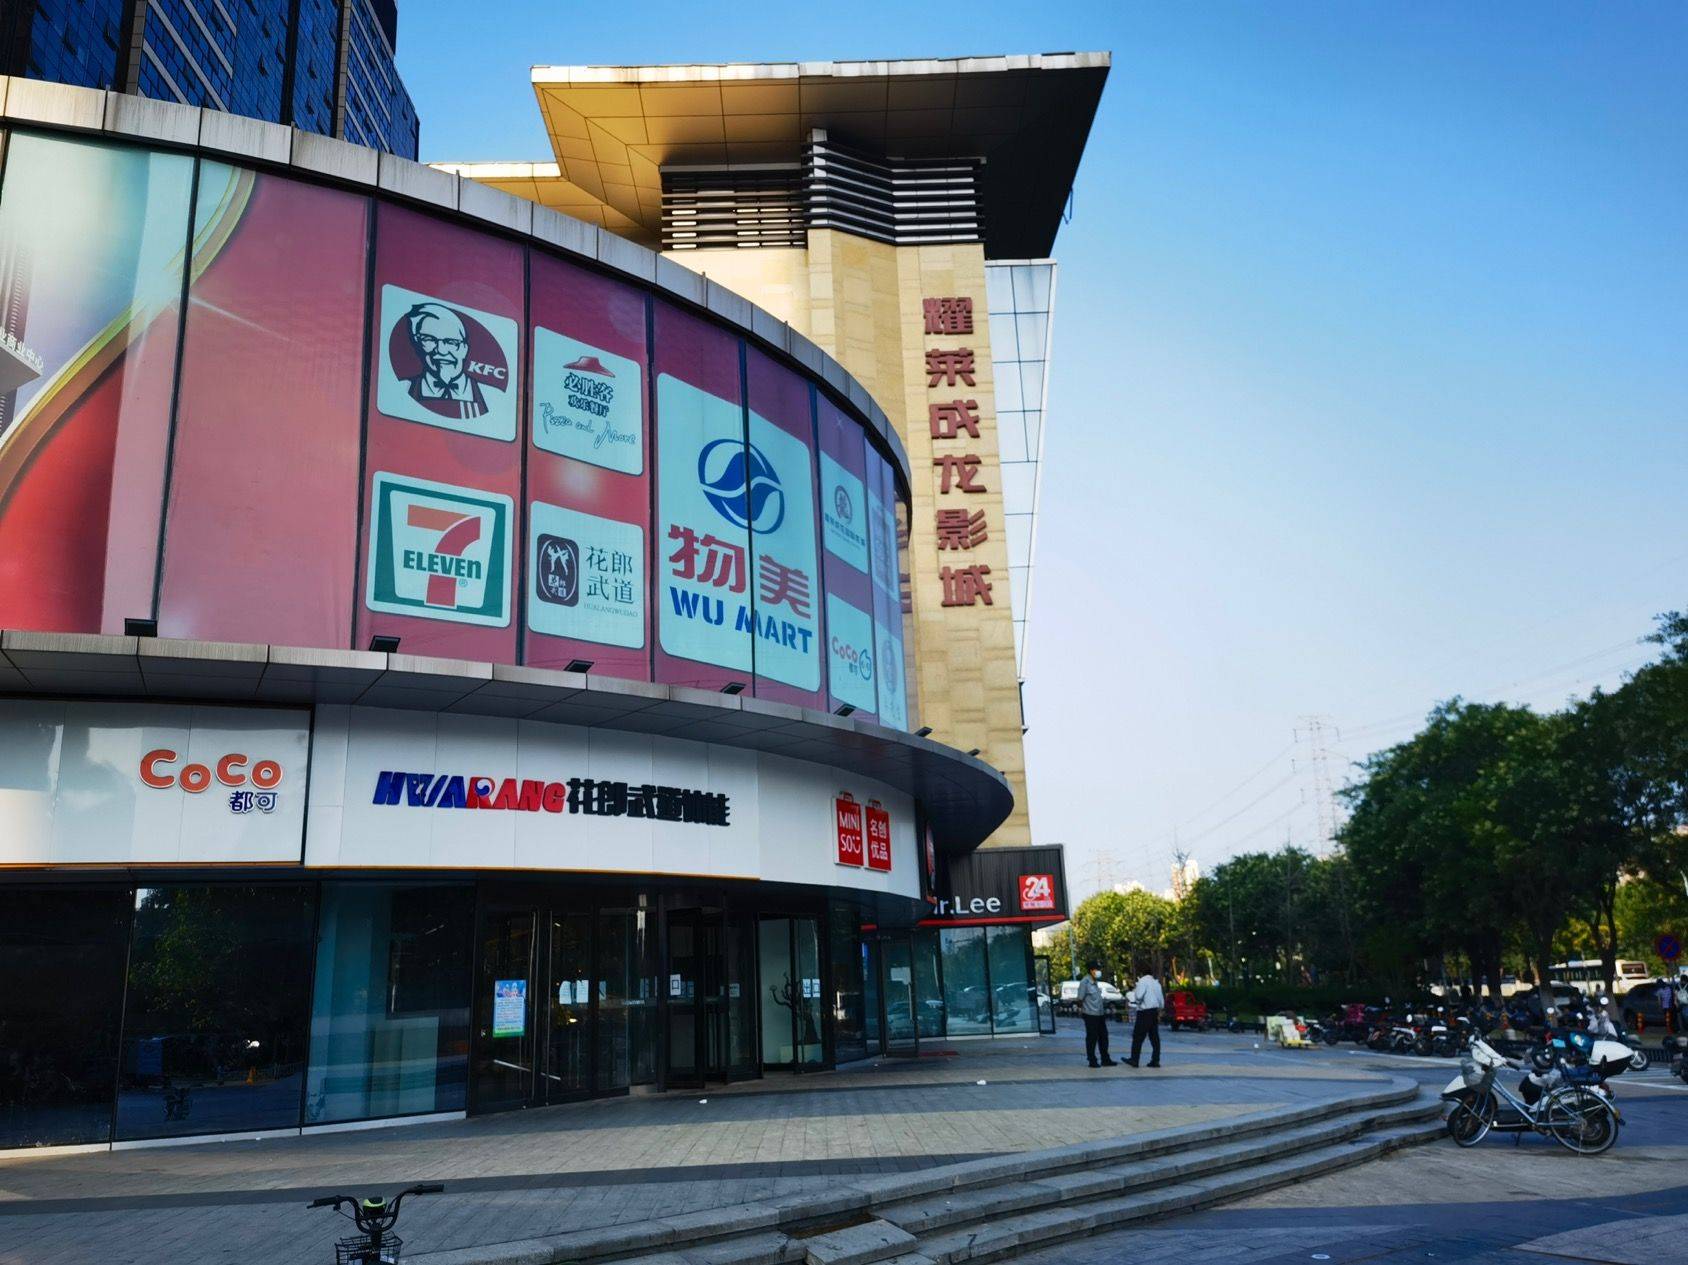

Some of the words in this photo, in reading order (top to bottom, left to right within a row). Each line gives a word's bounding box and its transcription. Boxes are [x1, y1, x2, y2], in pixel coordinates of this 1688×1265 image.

[468, 360, 506, 380] KFC
[564, 372, 613, 404] 必胜客
[922, 297, 994, 607] 耀莱成龙影城
[585, 545, 633, 575] 花郎
[668, 524, 812, 620] 物美
[586, 574, 634, 605] 武道
[669, 586, 724, 626] WU
[734, 605, 813, 654] MART
[229, 790, 279, 814] 都可
[839, 811, 860, 832] MINI
[870, 818, 887, 840] 名创
[870, 840, 889, 861] 优品
[1025, 876, 1050, 898] 24
